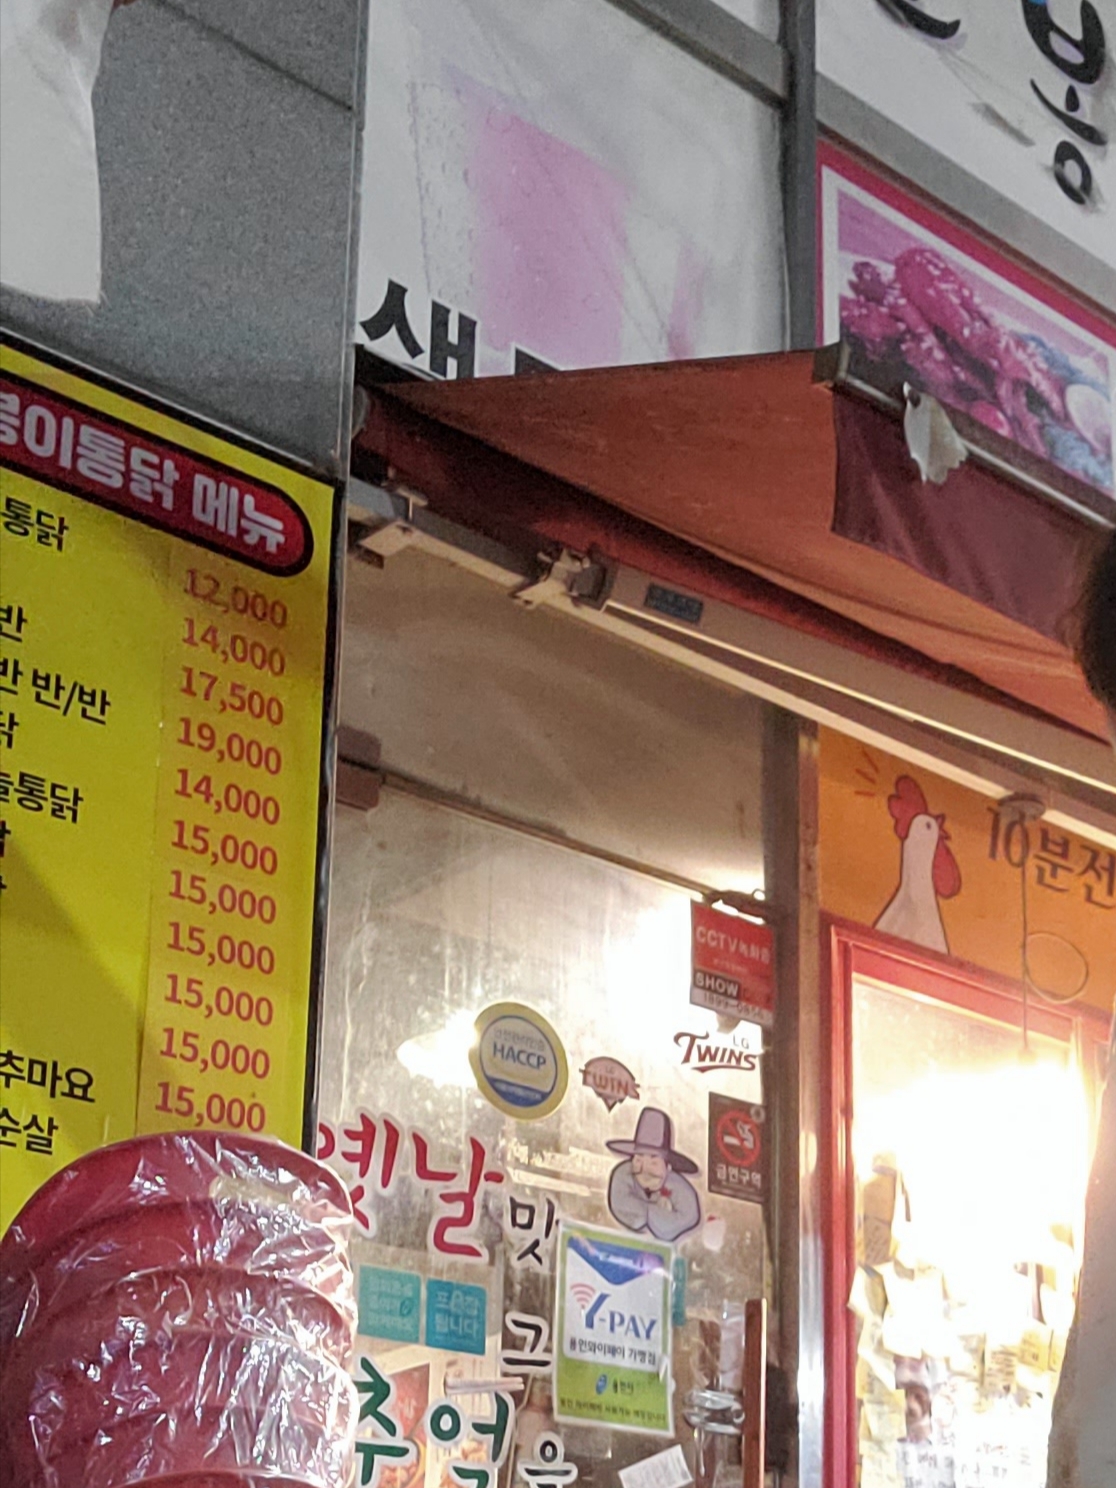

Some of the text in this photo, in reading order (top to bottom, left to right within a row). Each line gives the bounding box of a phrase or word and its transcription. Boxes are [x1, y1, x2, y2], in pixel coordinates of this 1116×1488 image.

[0, 497, 69, 552] 통닭
[192, 473, 286, 555] 메뉴
[183, 568, 288, 629] 12,000
[182, 617, 286, 677] 14,000
[32, 668, 111, 725] 반/반
[180, 665, 284, 726] 17,500
[177, 717, 282, 775] 19,000
[174, 768, 281, 825] 14,000
[171, 819, 278, 876] 15,000
[168, 869, 276, 925] 15,000
[166, 921, 275, 975] 15,000
[164, 973, 274, 1027] 15,000
[159, 1027, 270, 1080] 15,000
[493, 1042, 546, 1070] HACCP
[673, 1031, 757, 1073] TWINS
[155, 1081, 266, 1132] 15,000
[503, 1318, 552, 1368] 그
[581, 1292, 657, 1340] Y-PAY
